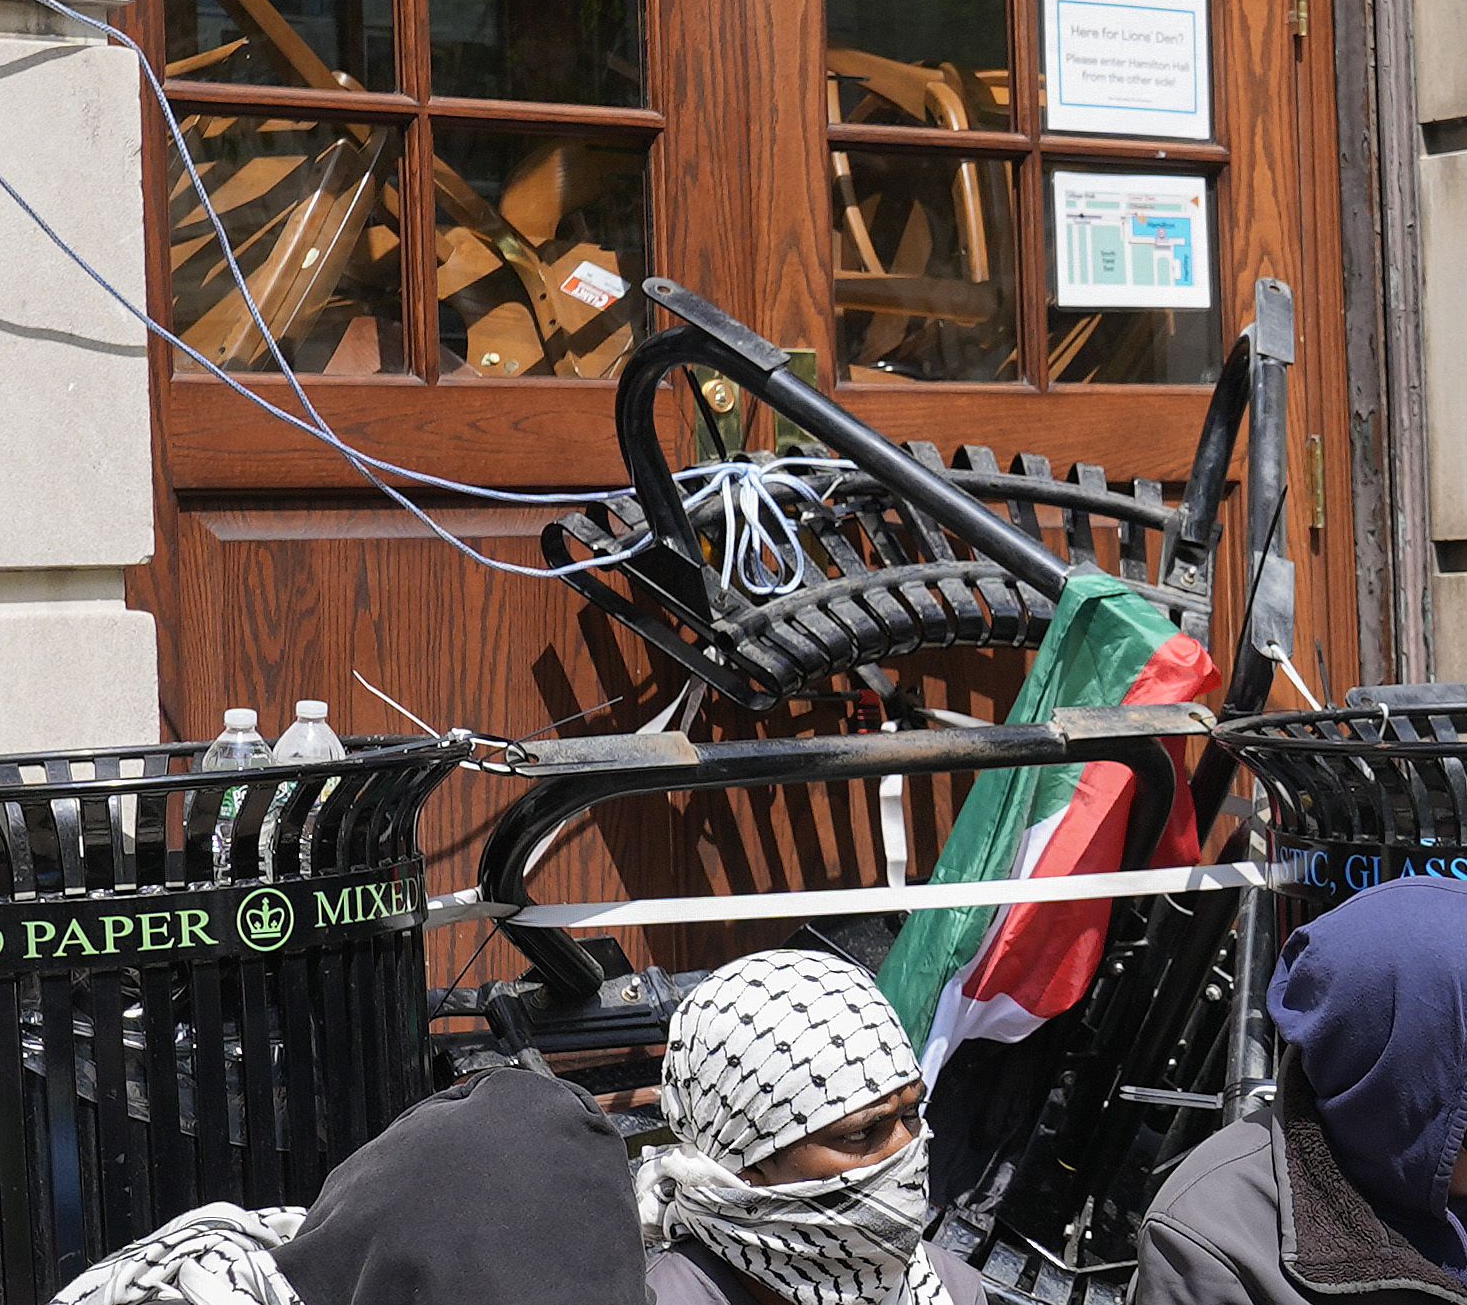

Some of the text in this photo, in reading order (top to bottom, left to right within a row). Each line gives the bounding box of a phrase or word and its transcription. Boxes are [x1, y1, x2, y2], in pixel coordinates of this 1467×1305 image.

[1070, 25, 1099, 39] Here
[1101, 26, 1119, 40] for
[1276, 846, 1336, 895] STIC,
[312, 877, 419, 928] MIXED
[23, 908, 219, 960] PAPER
